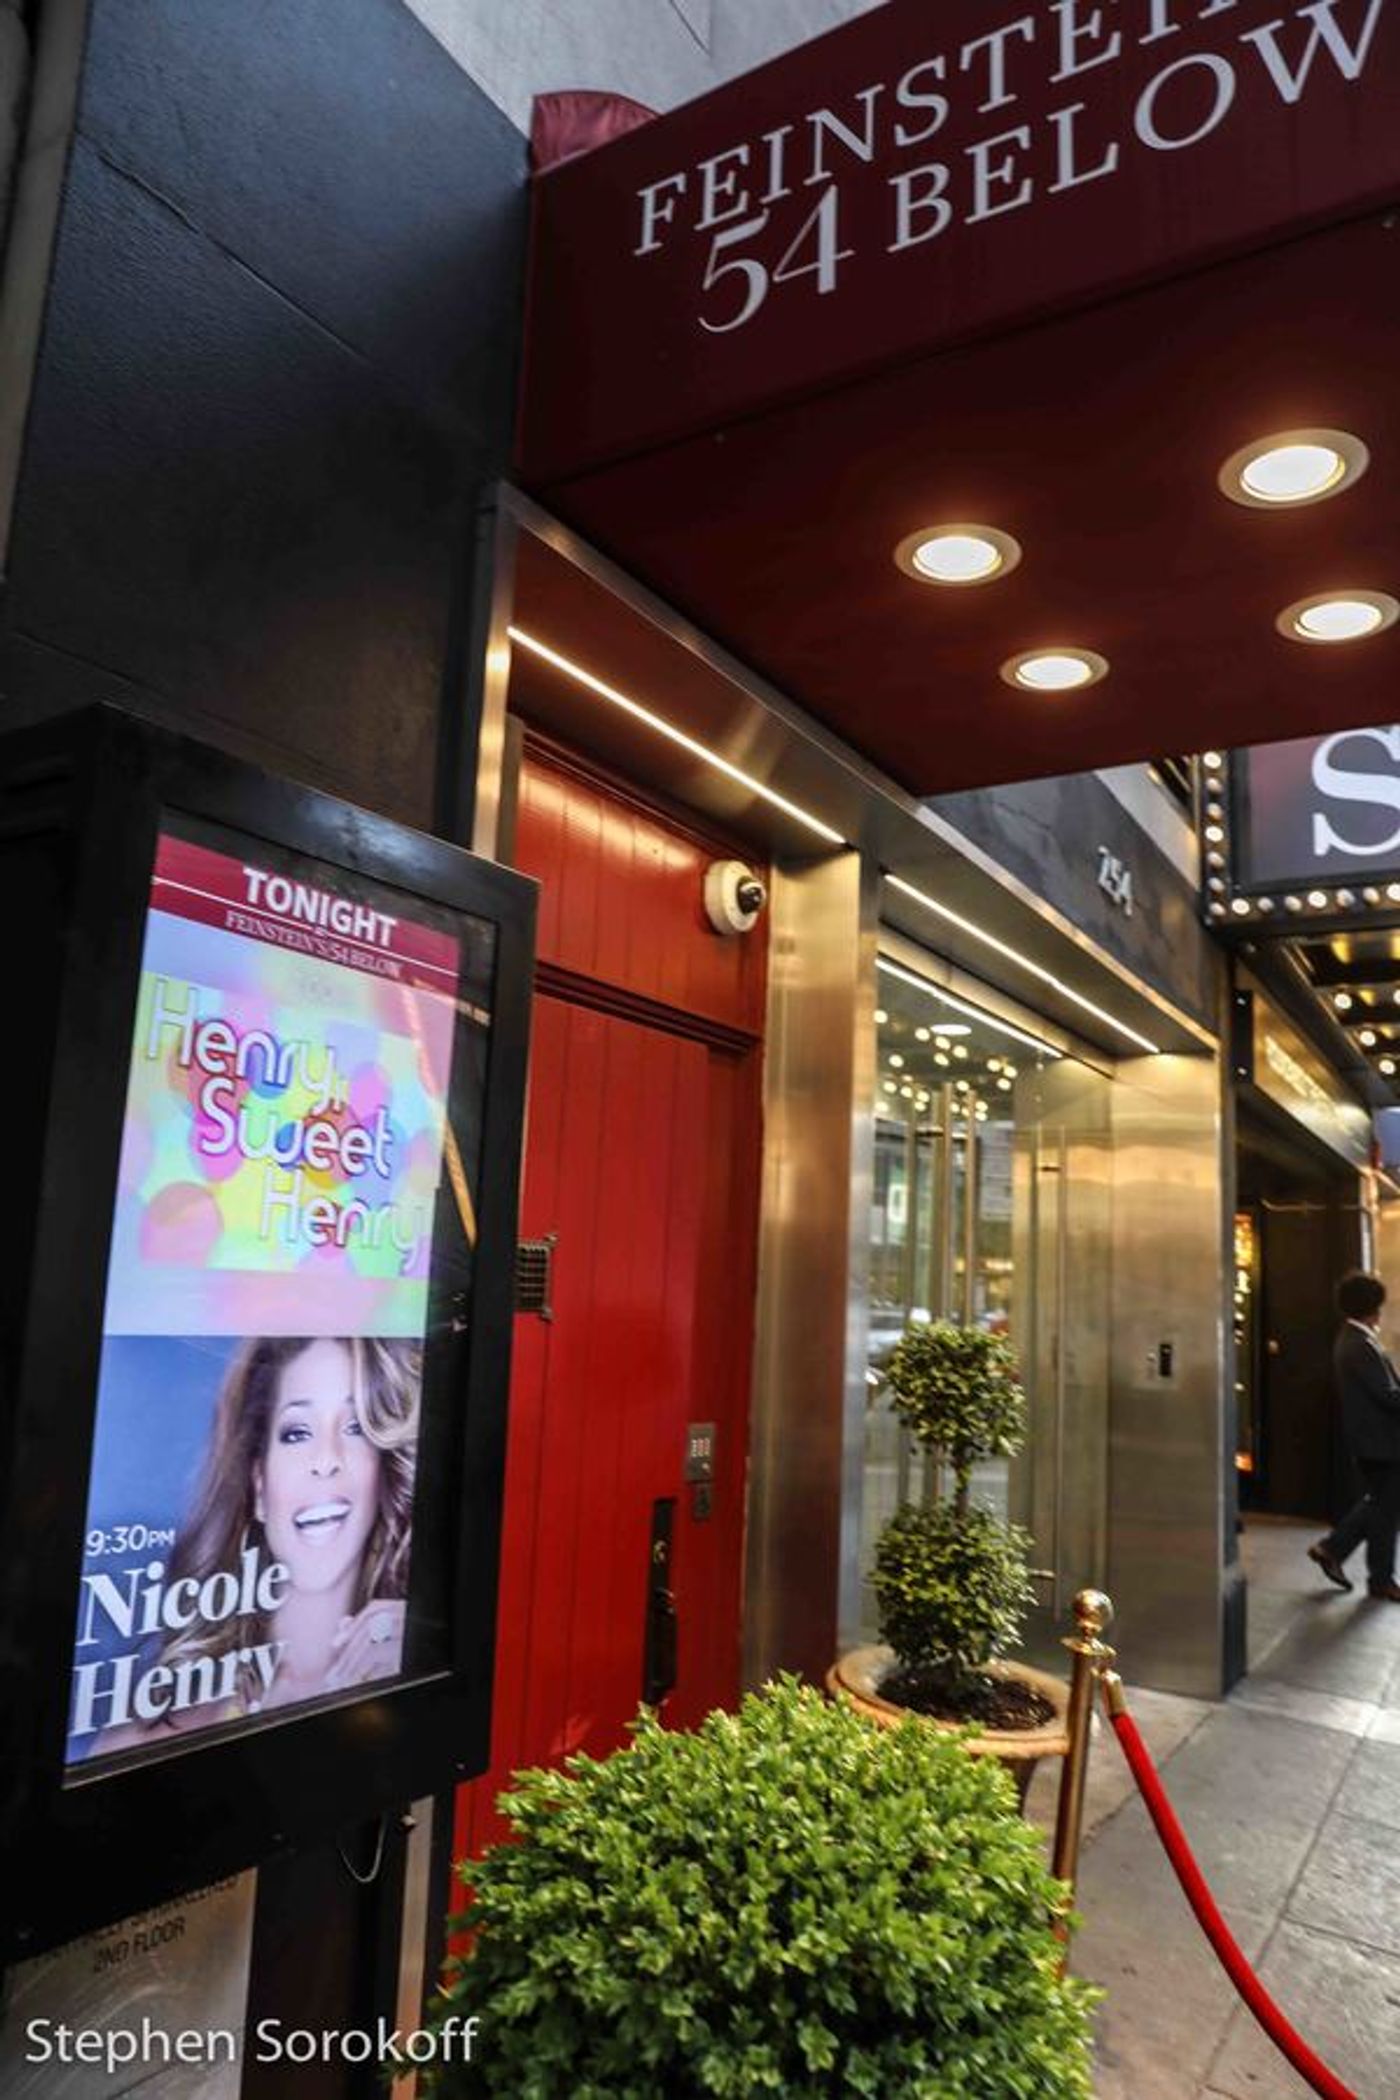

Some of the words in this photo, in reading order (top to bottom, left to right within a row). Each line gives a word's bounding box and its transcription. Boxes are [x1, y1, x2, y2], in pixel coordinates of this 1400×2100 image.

[634, 0, 1238, 256] FEINSTE
[697, 186, 855, 333] 54
[887, 0, 1384, 253] BELOW
[1311, 725, 1400, 857] S
[243, 868, 397, 946] TONIGHT
[147, 978, 346, 1116] Henry,
[200, 1078, 392, 1180] Sweet
[259, 1166, 427, 1267] Henry
[77, 1547, 290, 1647] Nicole
[70, 1642, 288, 1737] Henry
[134, 1918, 186, 1954] FLOOR
